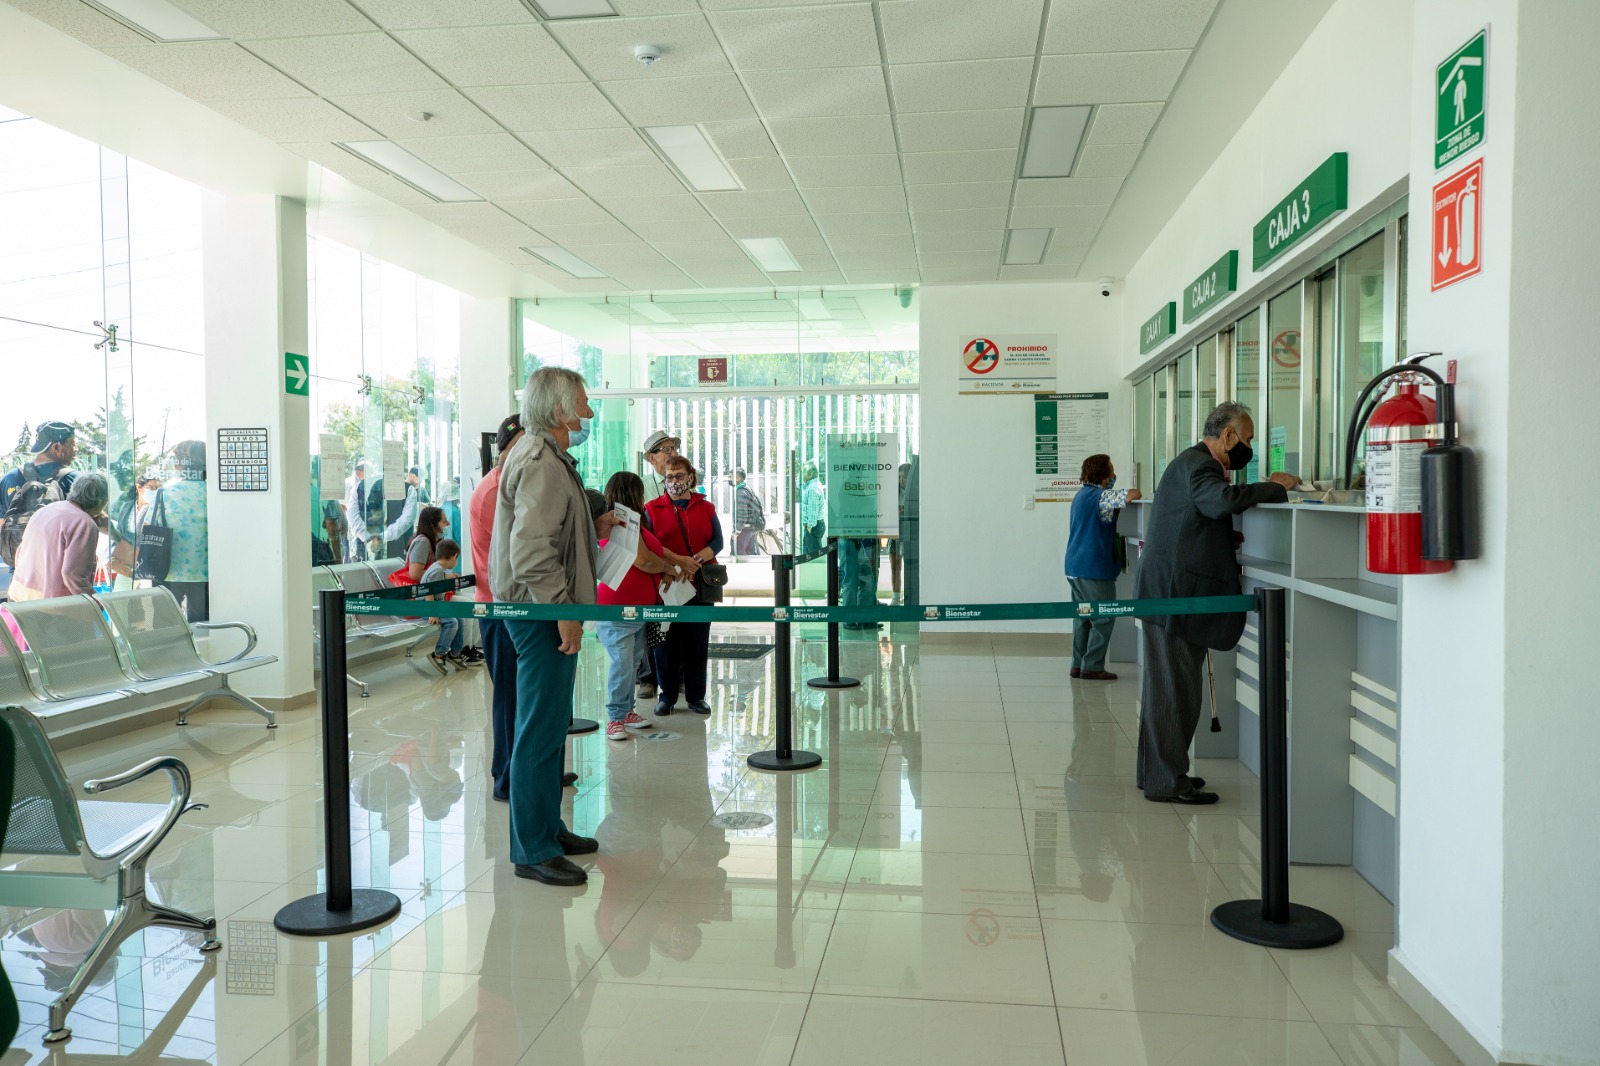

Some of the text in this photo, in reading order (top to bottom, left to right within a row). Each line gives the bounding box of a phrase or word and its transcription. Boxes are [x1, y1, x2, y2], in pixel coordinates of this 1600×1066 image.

[1446, 125, 1472, 149] ZONA DE
[1268, 189, 1310, 250] CAJA 3
[1192, 271, 1216, 309] CAJA 2
[1146, 318, 1158, 344] CAJA
[844, 482, 881, 490] BaBien
